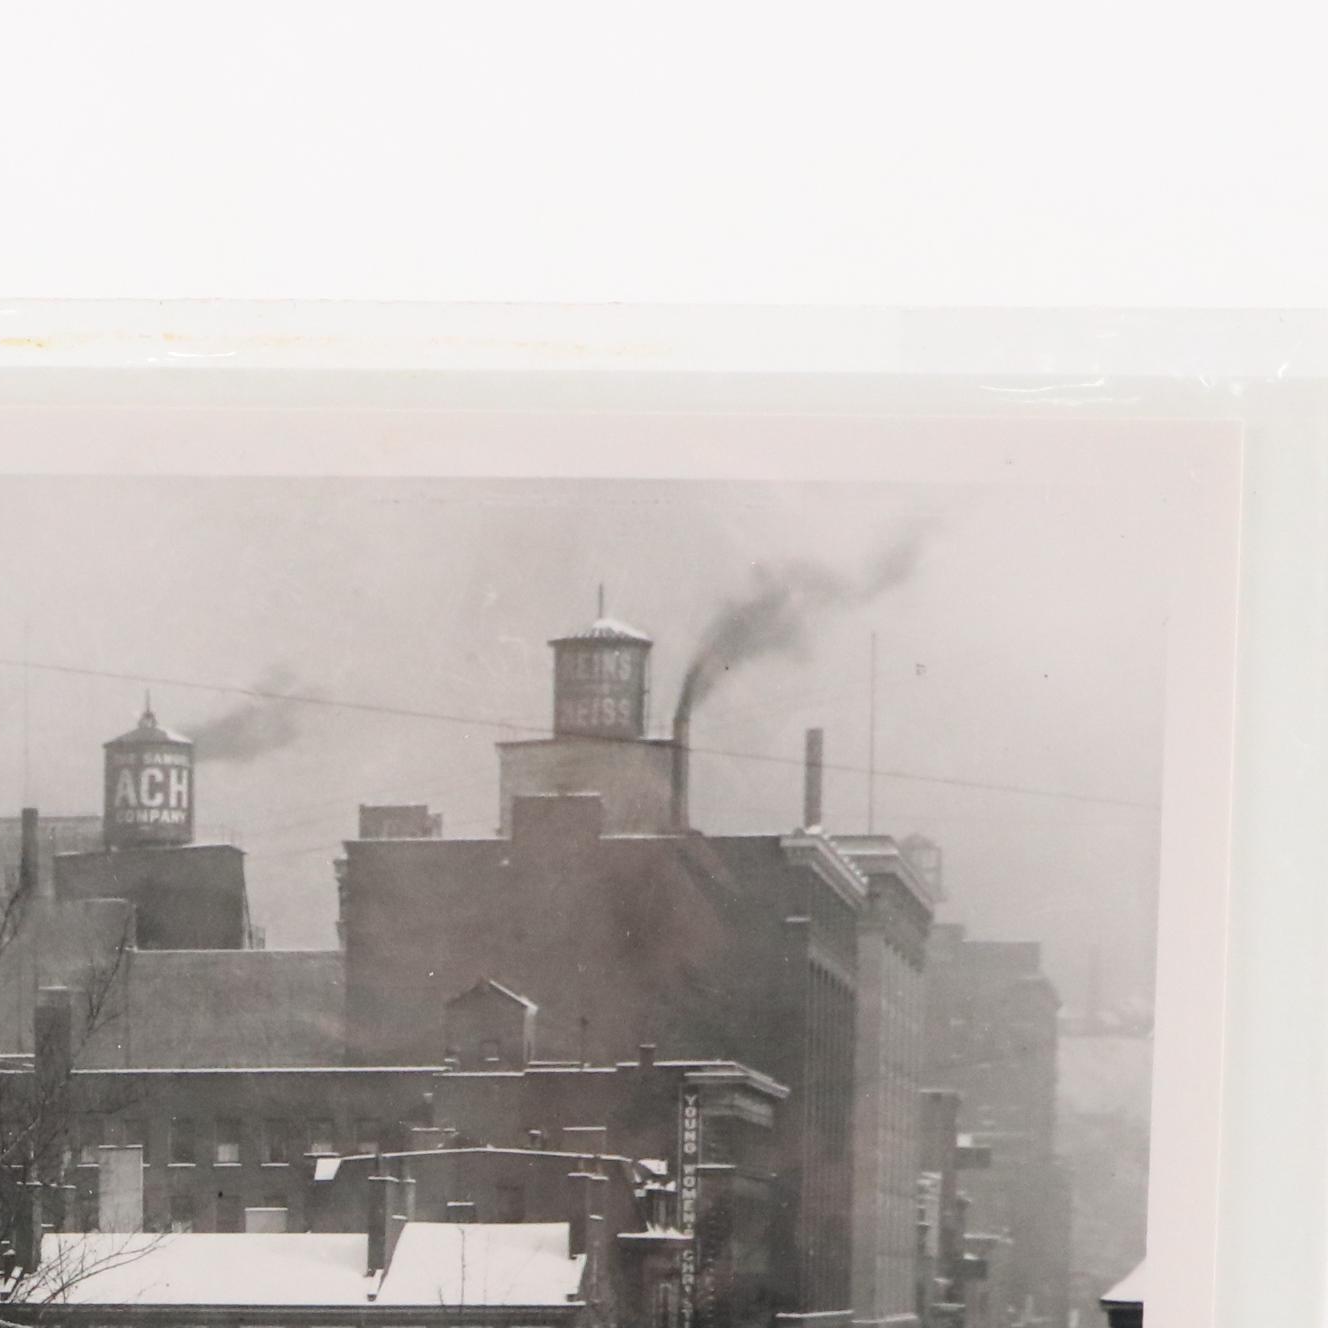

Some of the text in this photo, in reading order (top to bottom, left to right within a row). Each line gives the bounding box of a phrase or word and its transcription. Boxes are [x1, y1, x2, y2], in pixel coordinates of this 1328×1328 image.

[114, 766, 189, 809] ACH
[115, 808, 187, 824] COMPANY
[684, 1094, 697, 1154] YOUNG
